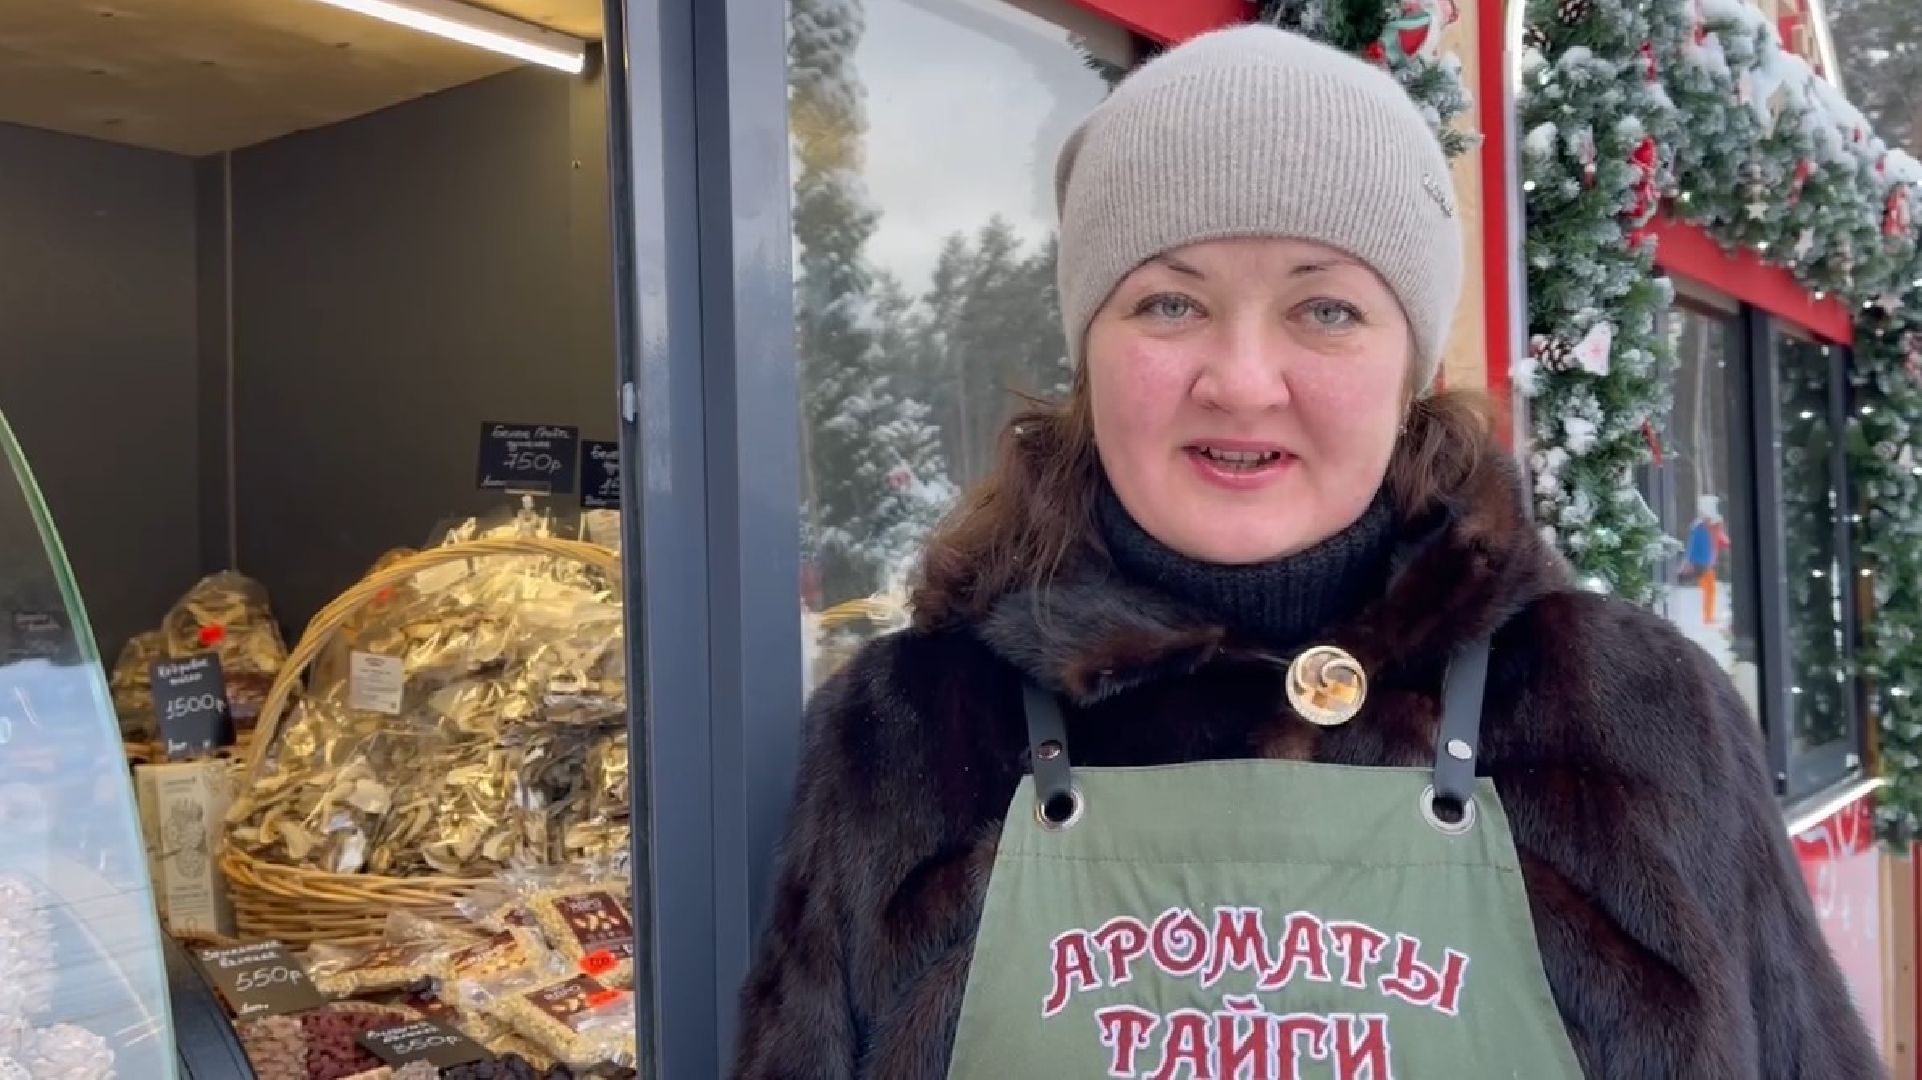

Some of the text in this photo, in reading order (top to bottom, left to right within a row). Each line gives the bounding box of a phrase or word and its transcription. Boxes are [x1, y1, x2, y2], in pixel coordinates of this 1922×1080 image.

[235, 965, 304, 992] 550р
[1042, 906, 1469, 1016] АРОМАТЫ
[1095, 994, 1395, 1080] ТАЙГИ
